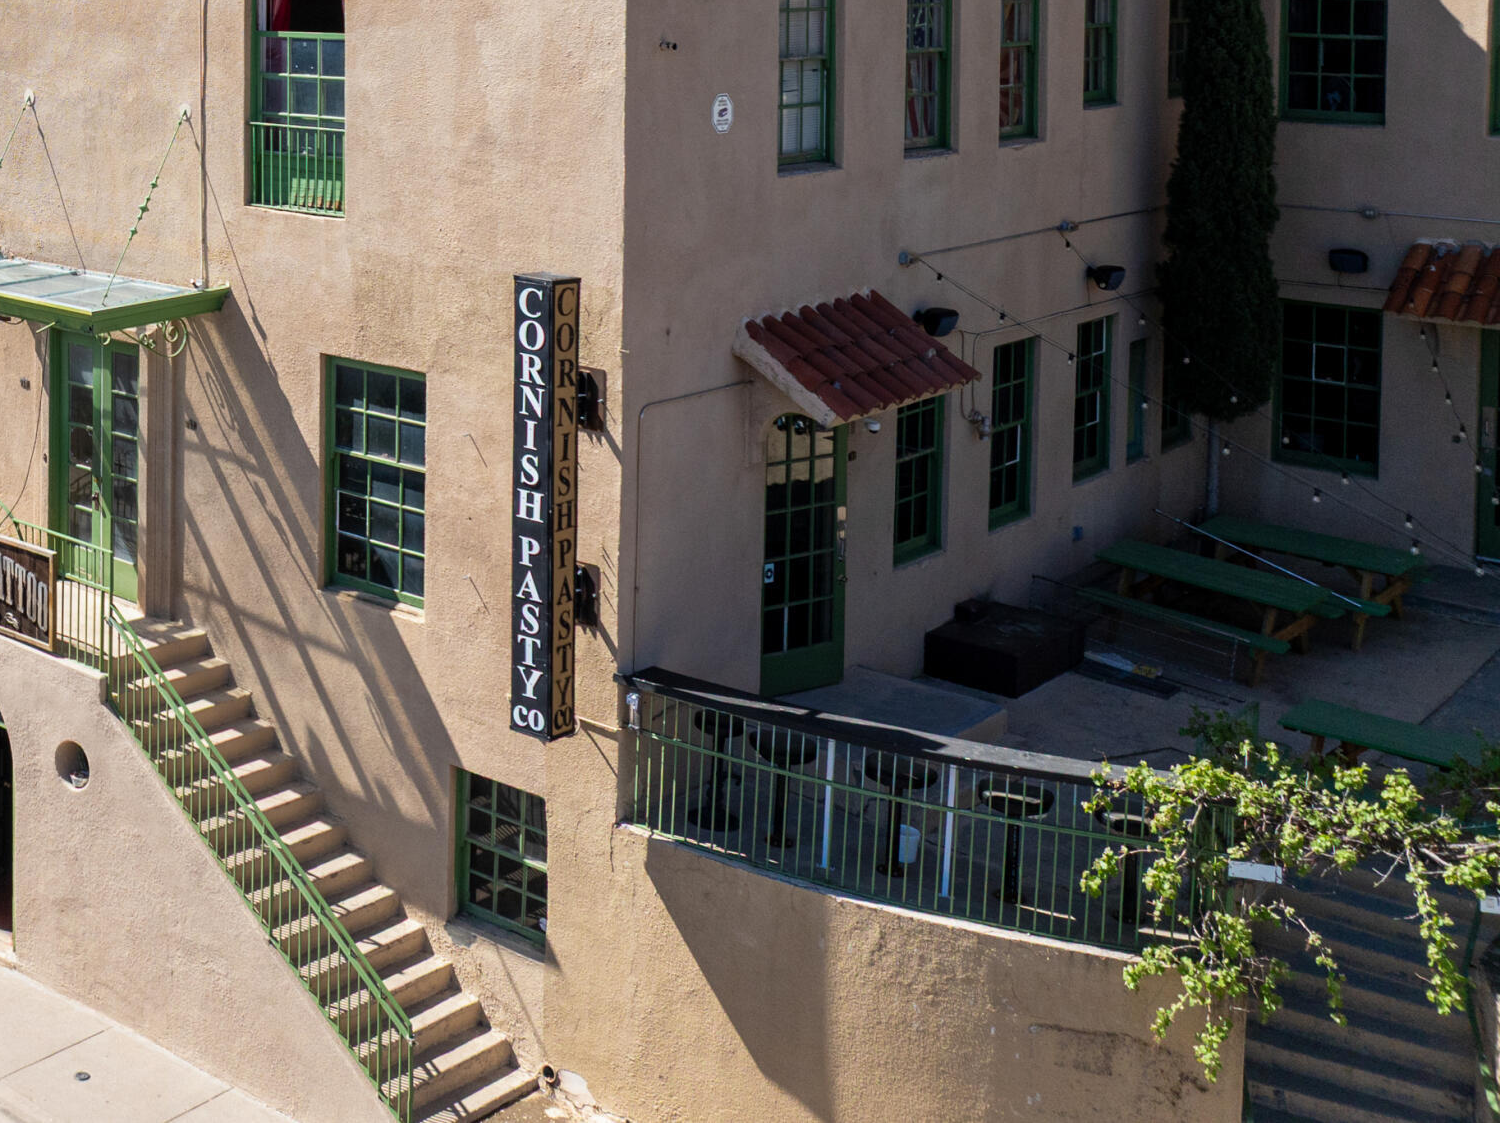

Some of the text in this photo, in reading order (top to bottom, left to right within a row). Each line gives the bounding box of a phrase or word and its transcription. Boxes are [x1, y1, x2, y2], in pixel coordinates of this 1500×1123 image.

[515, 287, 546, 524] CORNISH
[555, 284, 576, 534] CORNISH
[516, 535, 543, 701] PASTY
[556, 539, 572, 706] PASTY
